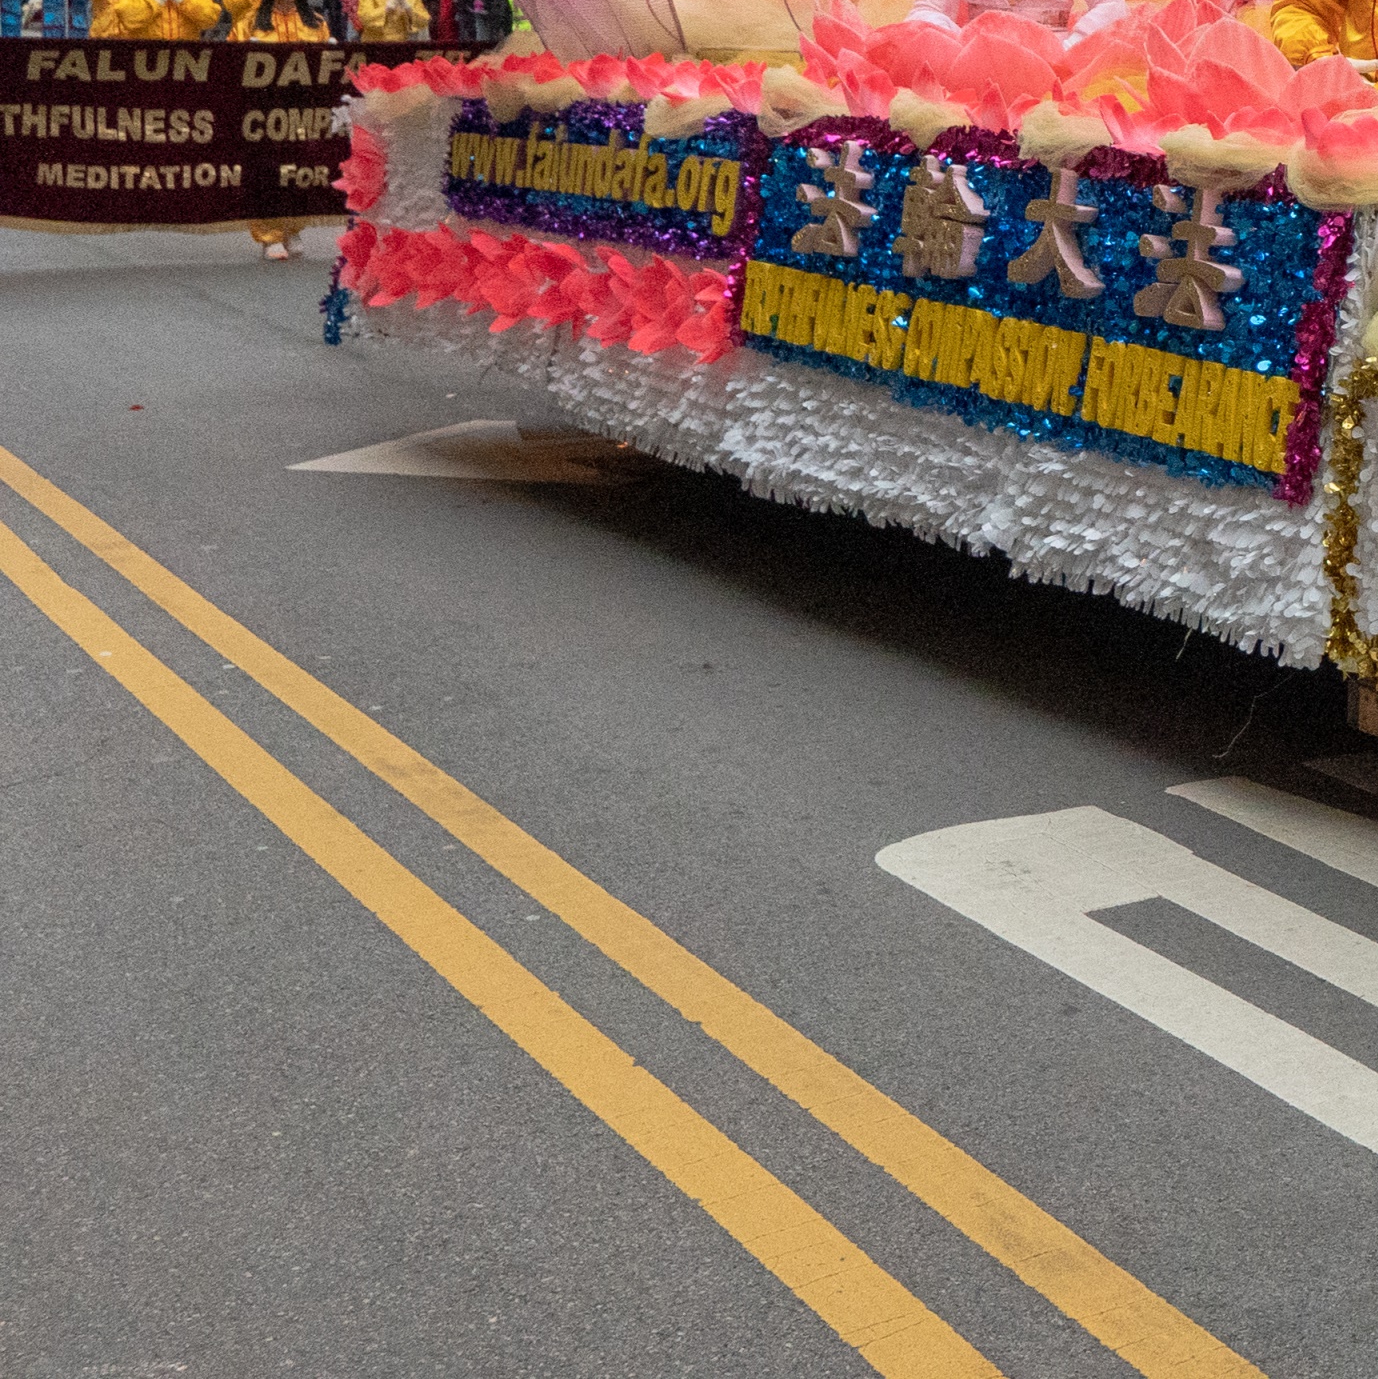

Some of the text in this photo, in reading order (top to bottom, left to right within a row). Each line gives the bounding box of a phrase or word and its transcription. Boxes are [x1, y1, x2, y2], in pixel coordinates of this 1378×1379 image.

[26, 49, 213, 83] FALUN
[0, 103, 214, 144] THFULNESS
[37, 163, 242, 190] MEDITATION
[450, 121, 742, 238] www.falundafa.org
